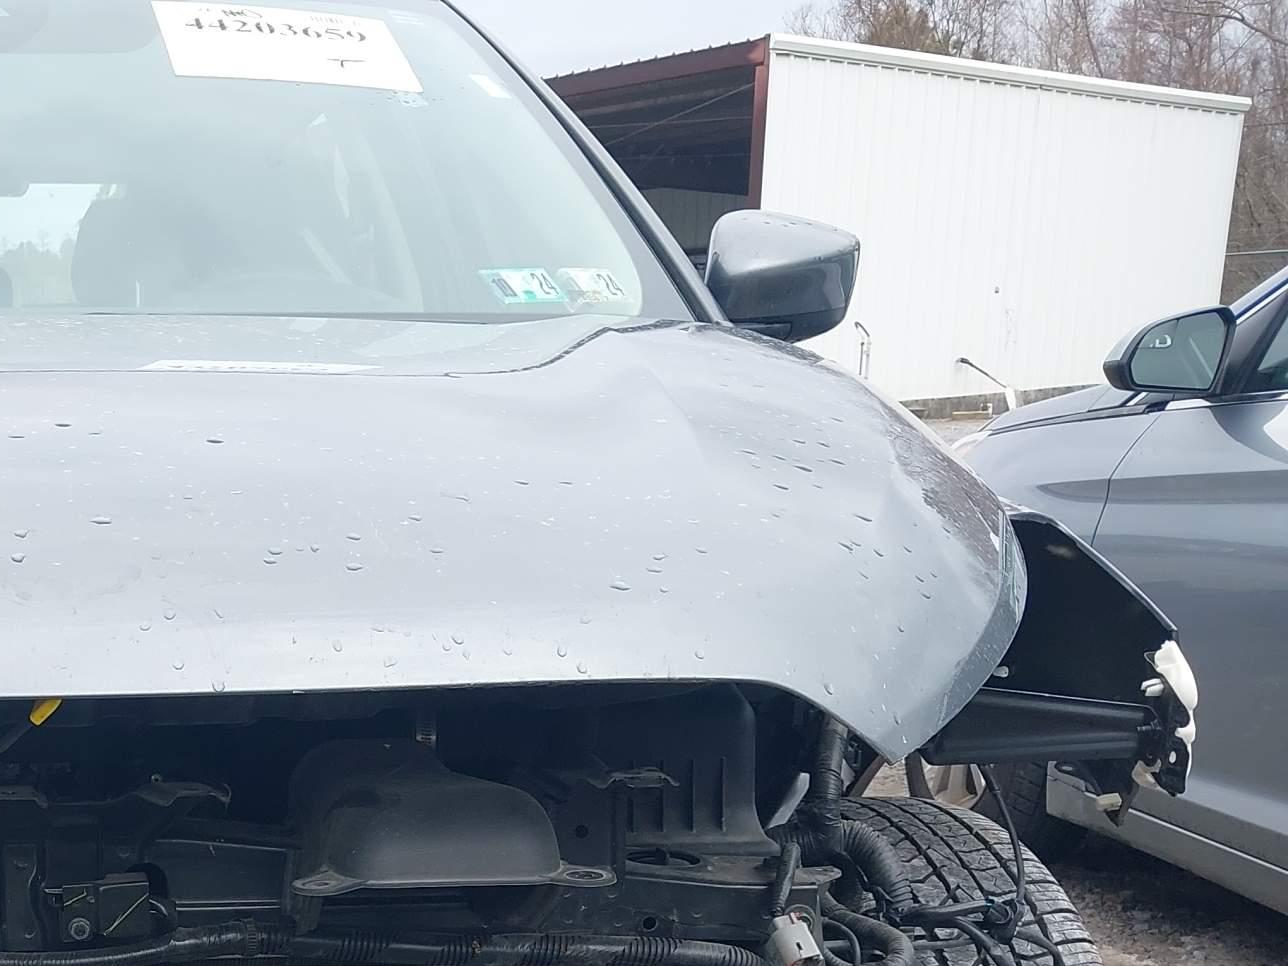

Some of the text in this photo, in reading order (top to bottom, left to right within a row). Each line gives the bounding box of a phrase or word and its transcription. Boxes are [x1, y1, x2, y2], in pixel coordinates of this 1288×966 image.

[185, 17, 367, 42] 44203659
[529, 272, 560, 297] 24
[595, 273, 626, 297] 24
